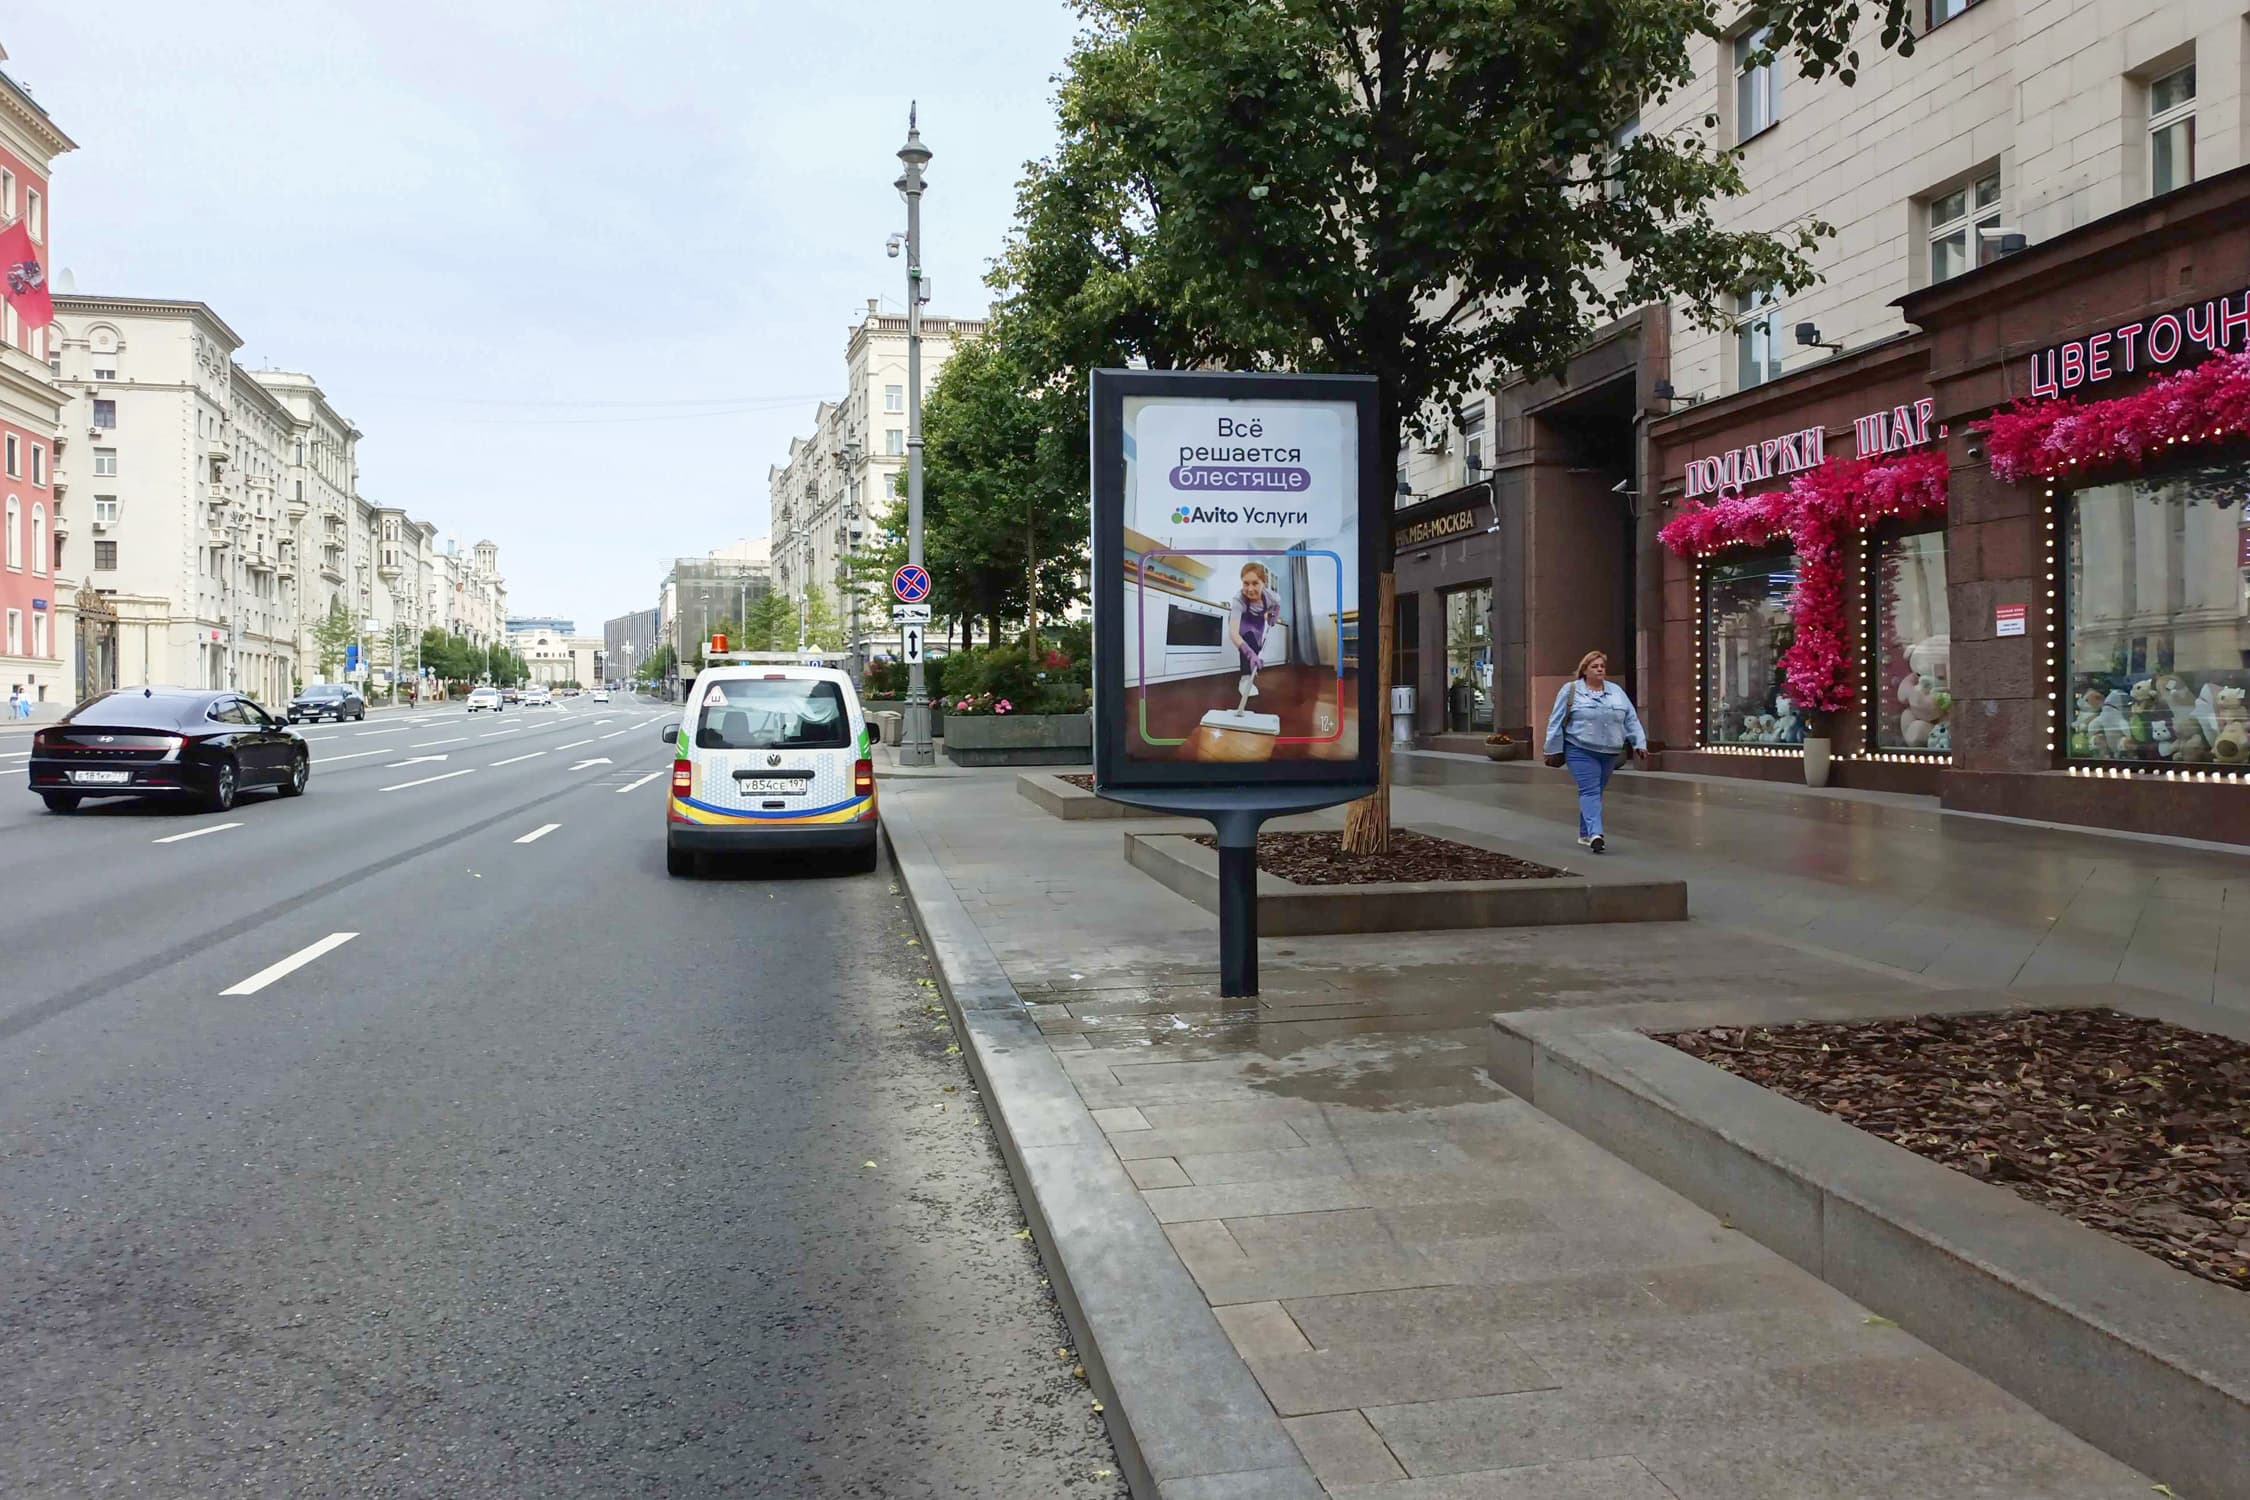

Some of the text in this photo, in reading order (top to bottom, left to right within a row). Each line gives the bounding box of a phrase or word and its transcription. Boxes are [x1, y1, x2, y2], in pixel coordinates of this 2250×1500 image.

[1218, 417, 1263, 438] Всё
[1179, 446, 1301, 466] решается
[1684, 397, 1948, 499] ПОДАРКИ ШАР
[1178, 466, 1303, 490] блестяще
[1191, 506, 1308, 528] Avito Услуги
[1320, 715, 1335, 732] 12+
